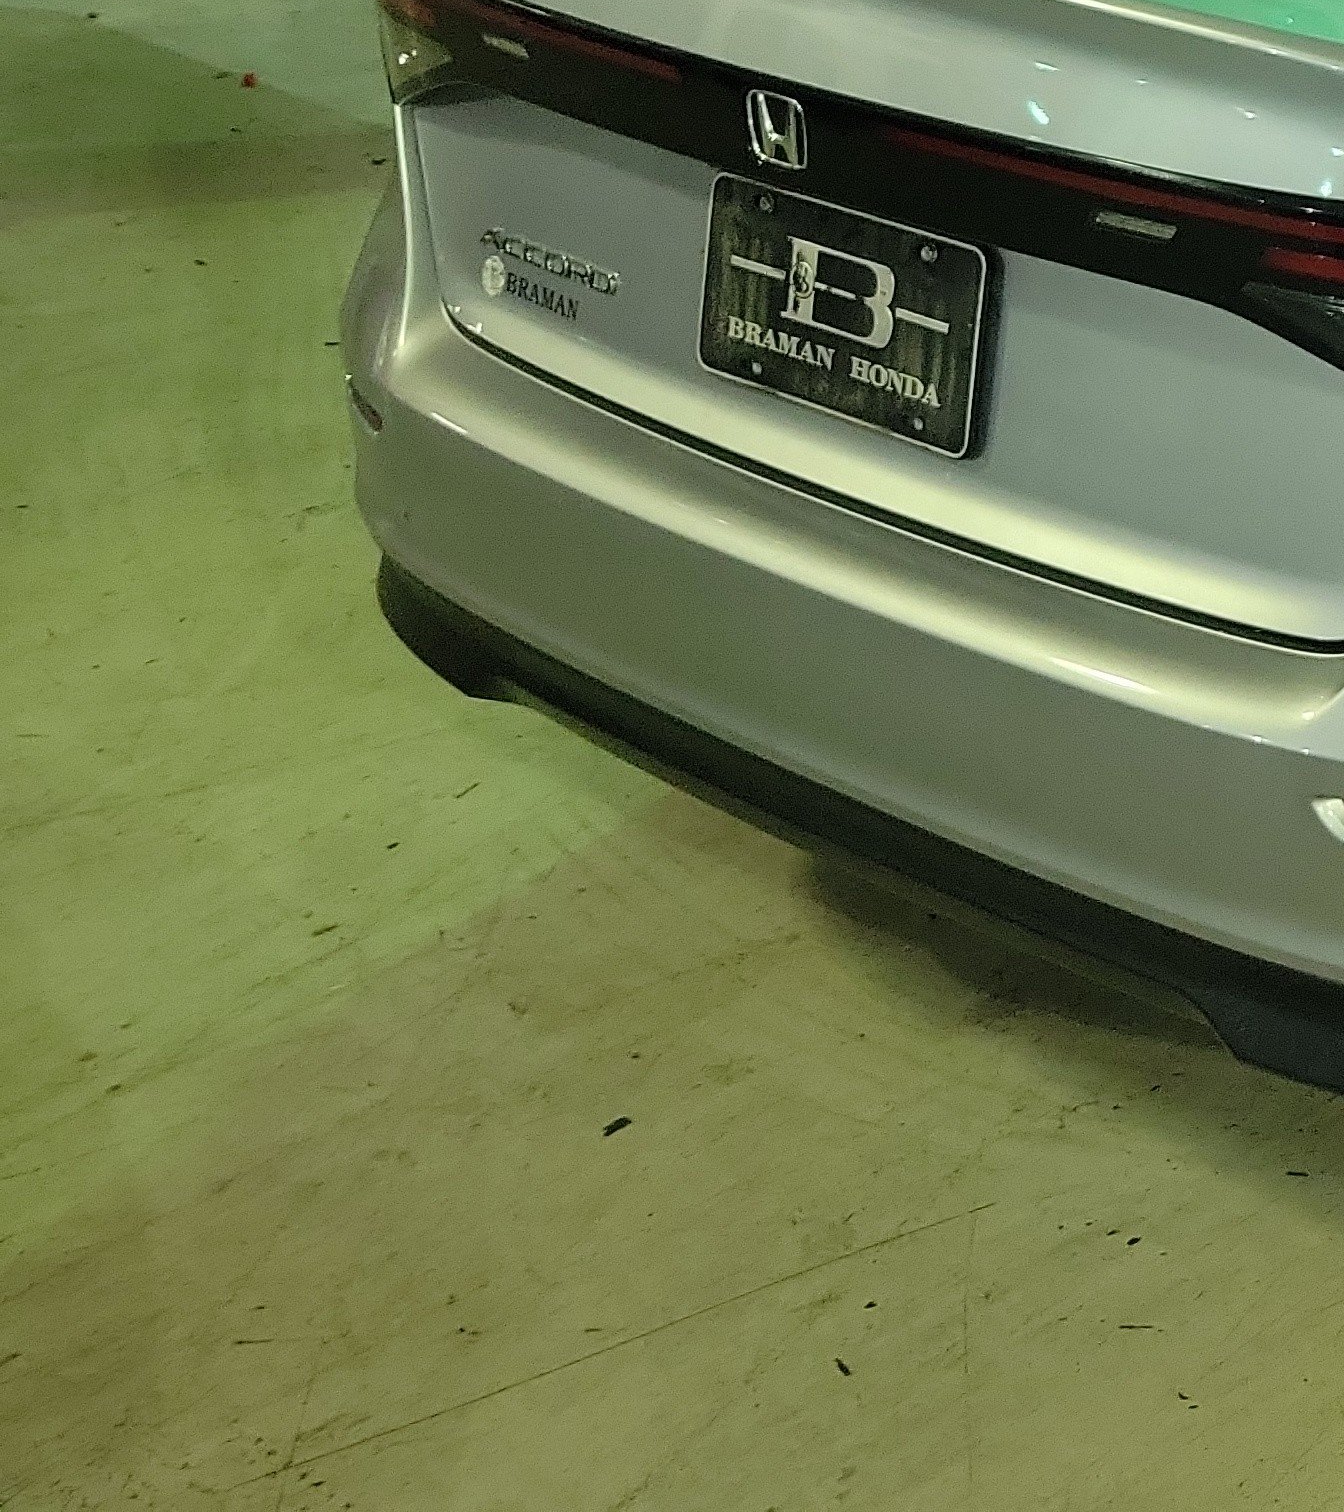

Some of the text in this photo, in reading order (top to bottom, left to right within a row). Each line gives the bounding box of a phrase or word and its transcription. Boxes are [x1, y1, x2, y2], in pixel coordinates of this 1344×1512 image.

[480, 228, 621, 296] ACCORD
[506, 272, 580, 320] BRAMAN
[780, 235, 896, 350] B
[727, 315, 942, 409] BRAMAN HONDA
